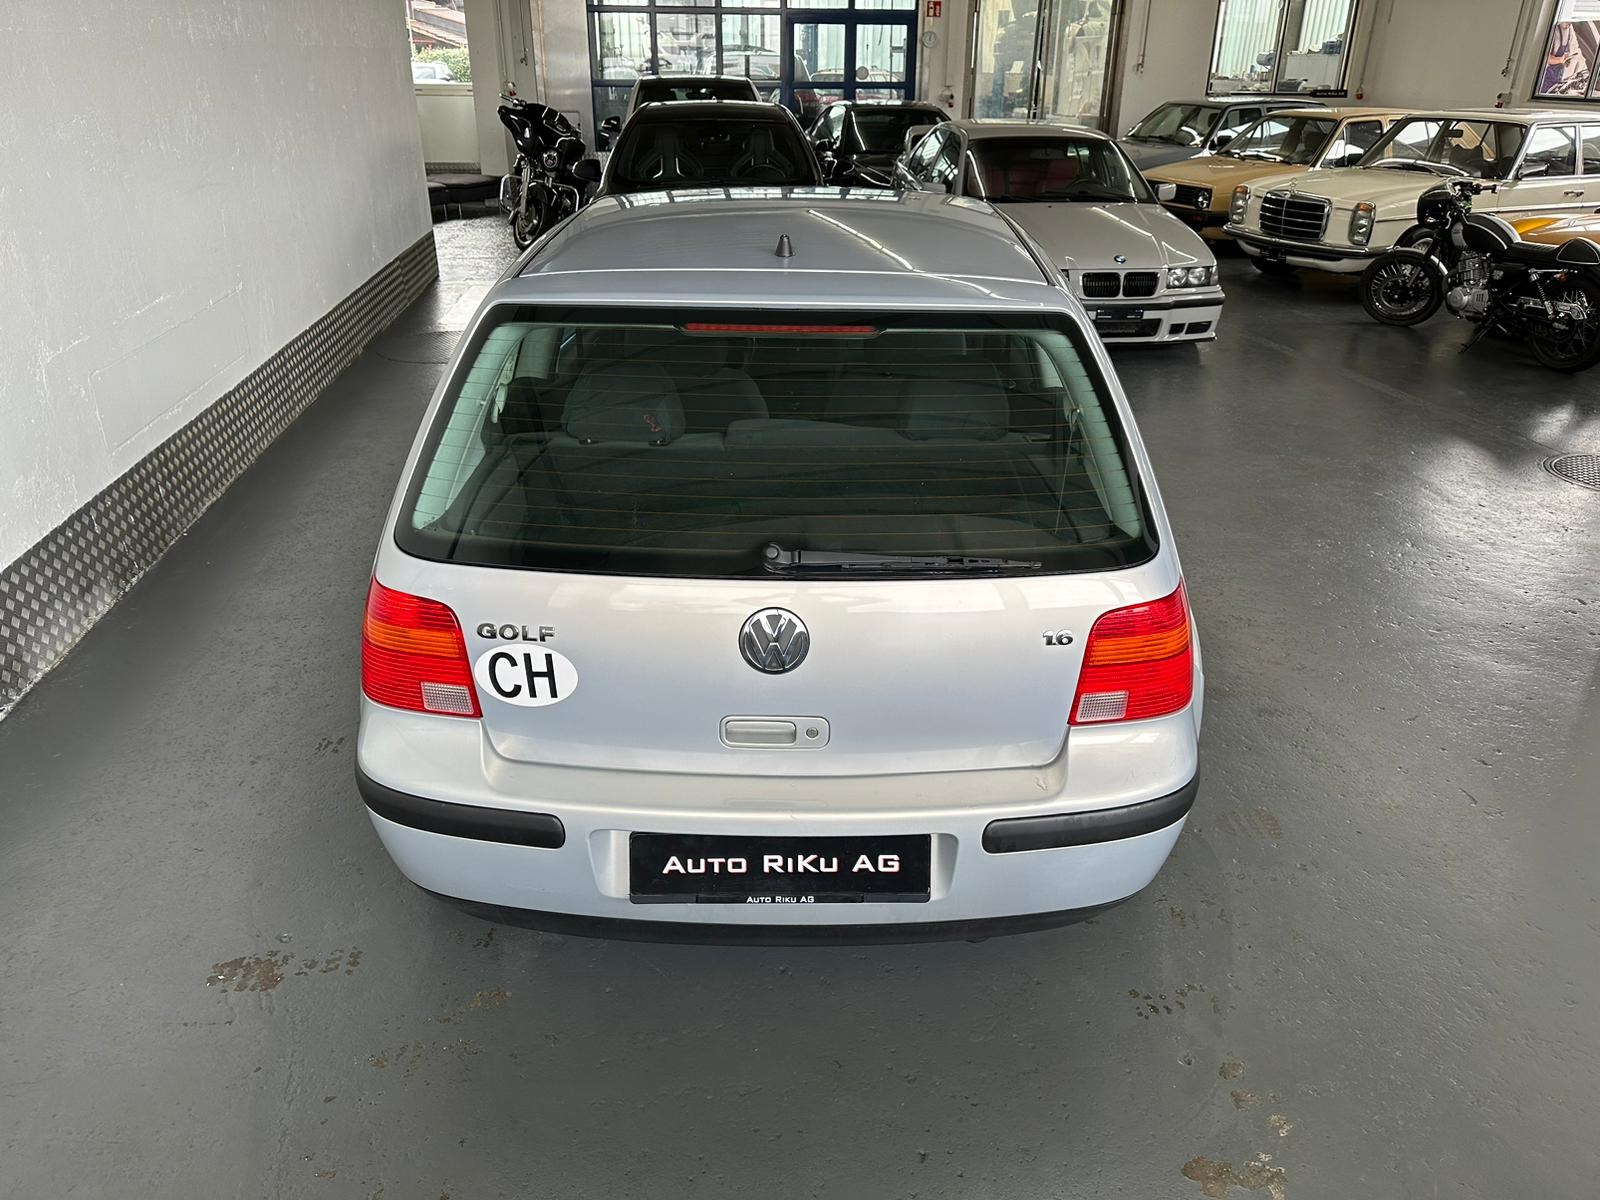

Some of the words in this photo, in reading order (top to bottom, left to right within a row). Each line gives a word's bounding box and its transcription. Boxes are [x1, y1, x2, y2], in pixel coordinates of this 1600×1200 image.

[476, 622, 556, 642] GOLF
[488, 651, 558, 699] CH
[852, 854, 900, 873] AG
